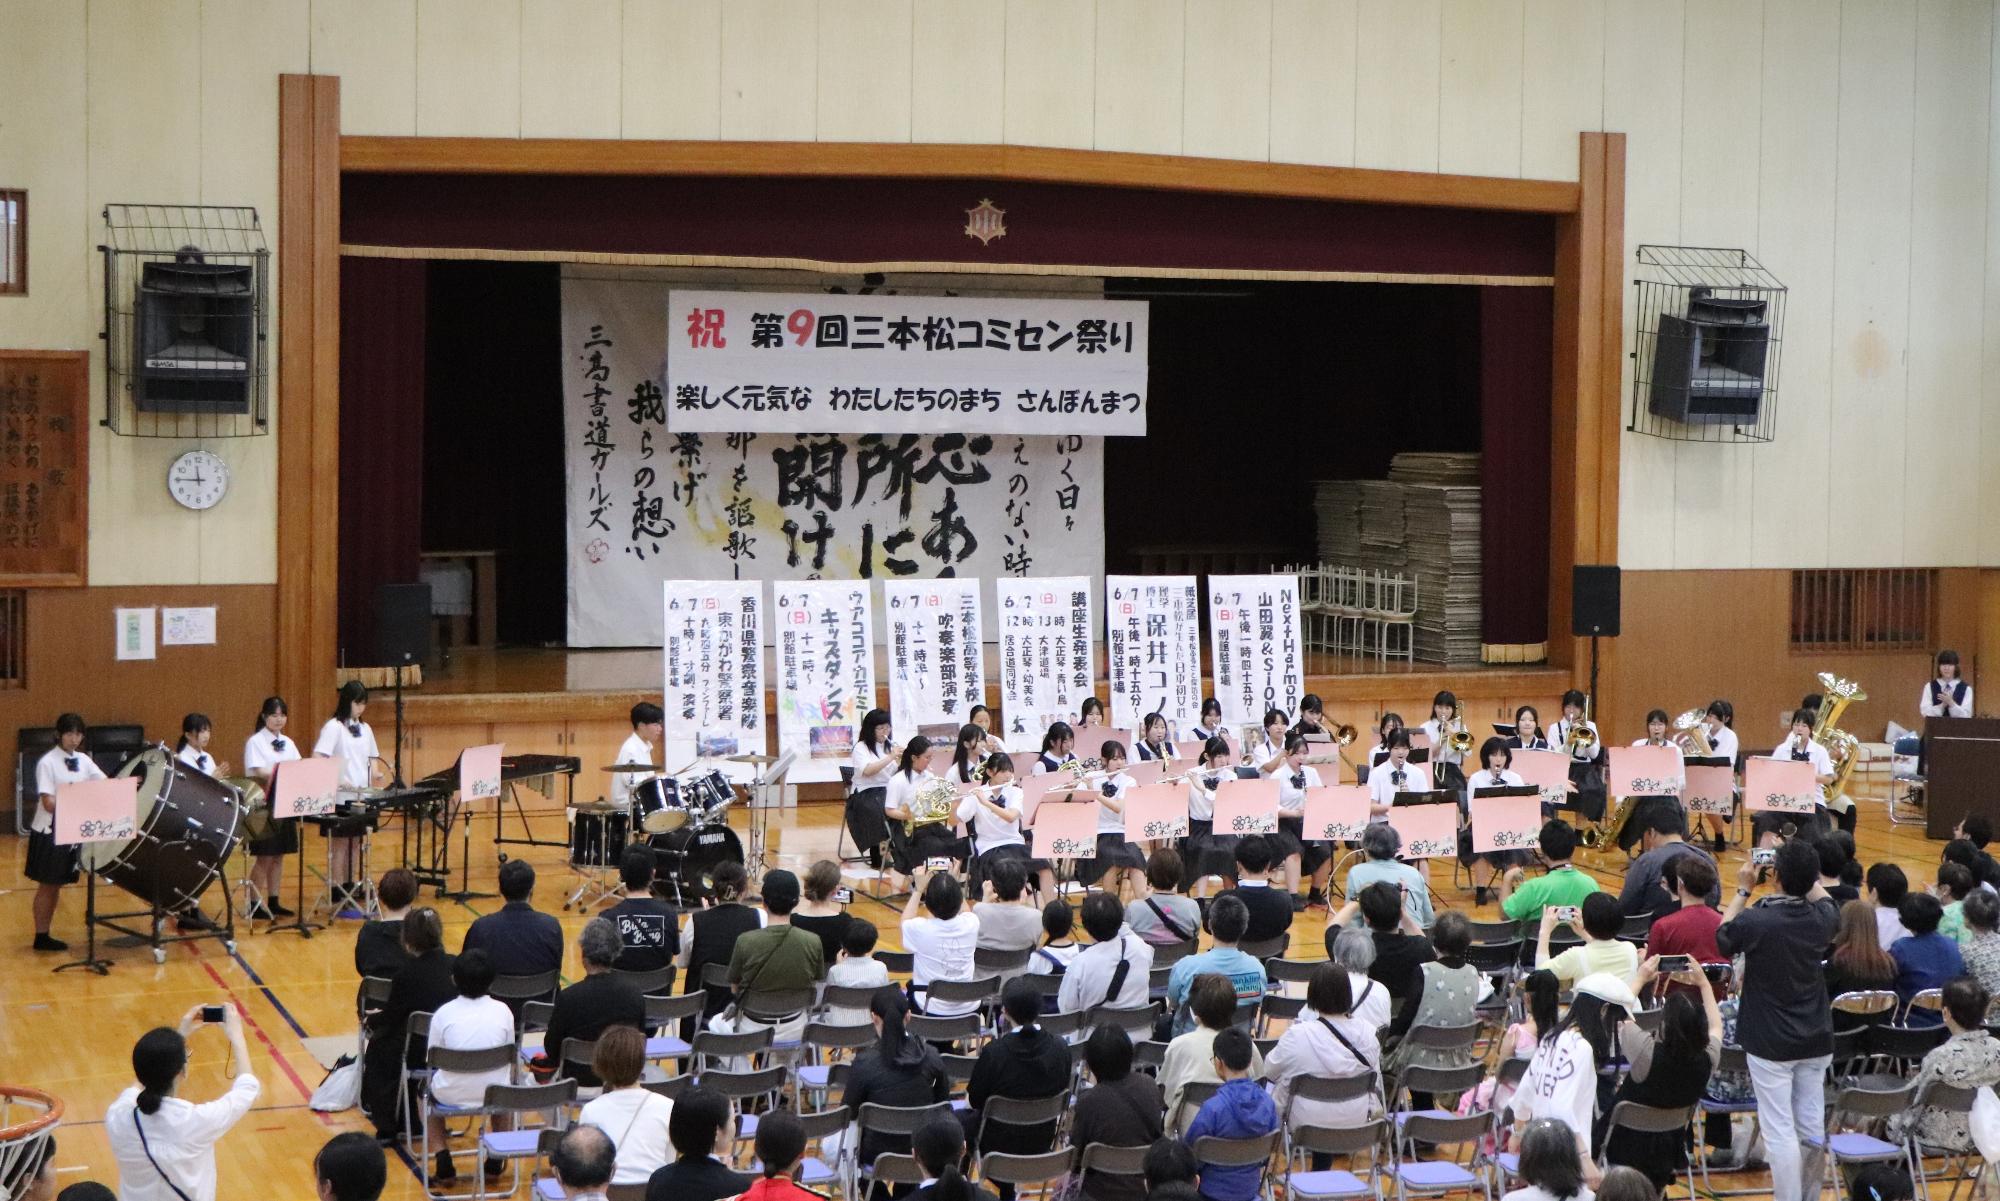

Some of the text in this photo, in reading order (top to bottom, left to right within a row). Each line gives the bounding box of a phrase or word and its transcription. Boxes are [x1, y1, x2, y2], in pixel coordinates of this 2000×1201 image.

[688, 308, 1133, 354] 祝 第9回三本松コミセン祭り
[677, 384, 1140, 414] 楽しく元気な わたしたちのまち さんぼんまつ
[821, 608, 843, 720] キッズダンス
[938, 612, 958, 716] 吹奏楽部演奏
[960, 594, 980, 703] 三本松高等学校
[1071, 591, 1088, 688] 講座生発表会
[700, 833, 725, 845] YAMAHA
